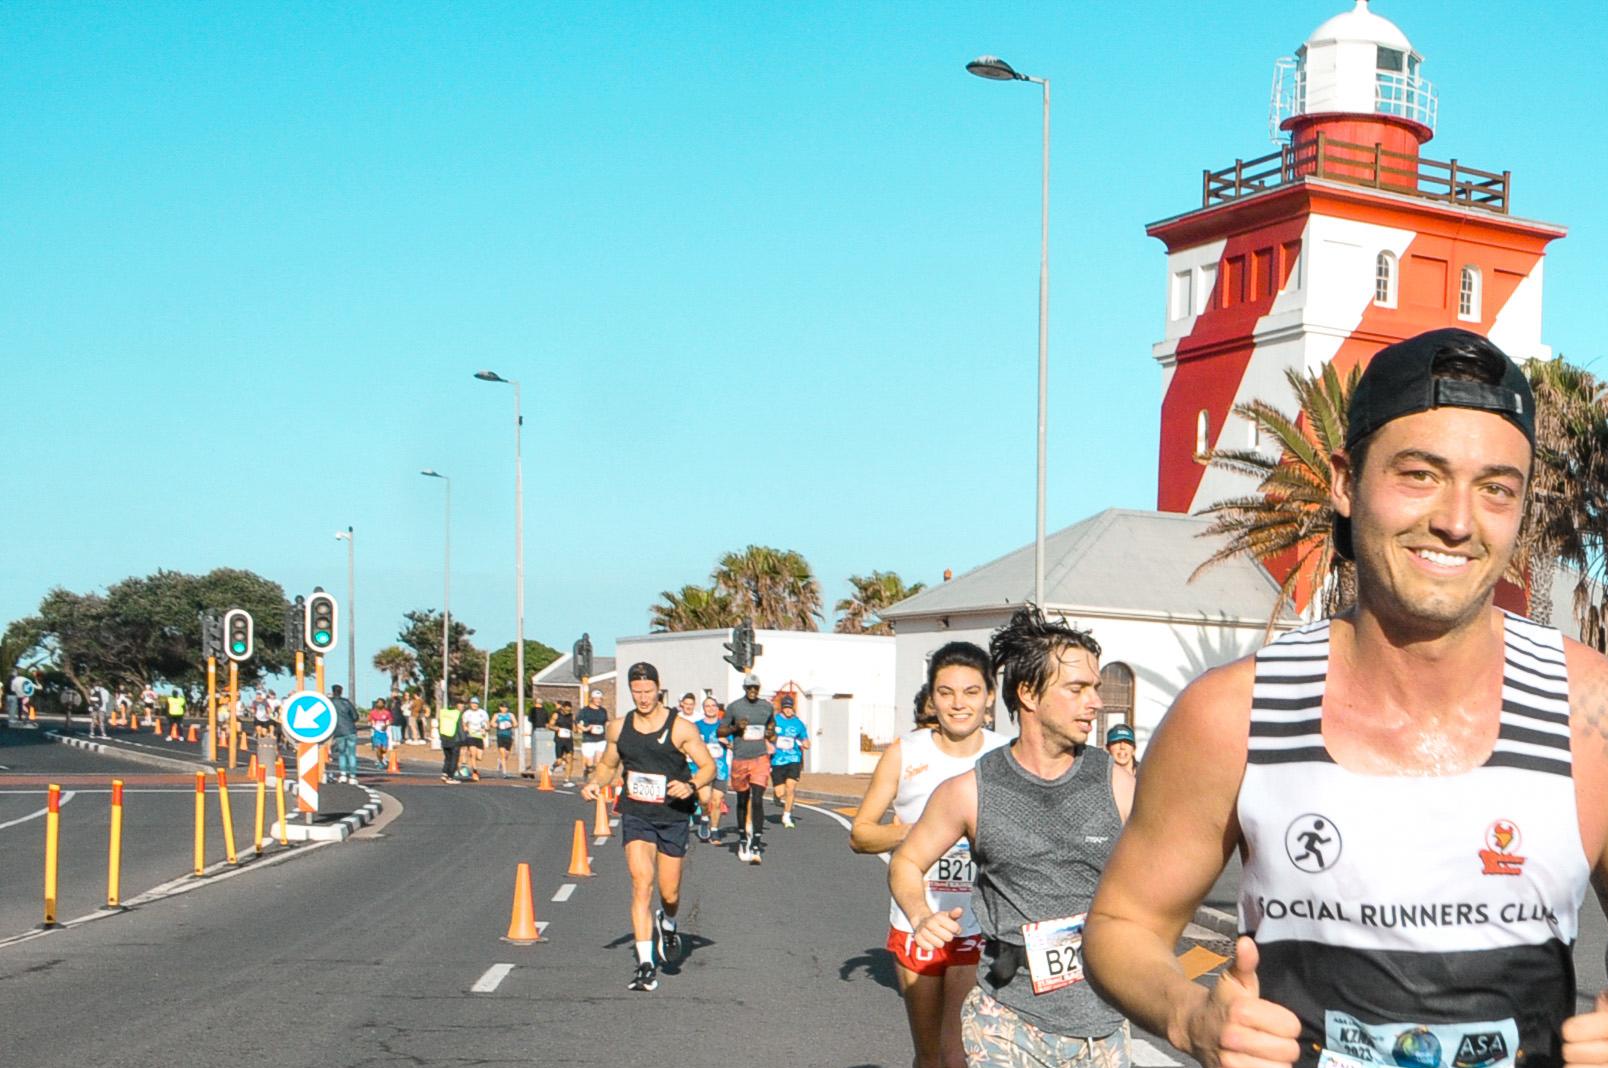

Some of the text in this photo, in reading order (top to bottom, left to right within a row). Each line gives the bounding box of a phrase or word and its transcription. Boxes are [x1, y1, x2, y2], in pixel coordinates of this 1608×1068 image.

[939, 859, 972, 881] B21
[1360, 903, 1489, 929] RUNNERS
[1046, 946, 1083, 976] B2
[1460, 1034, 1503, 1058] ASA
